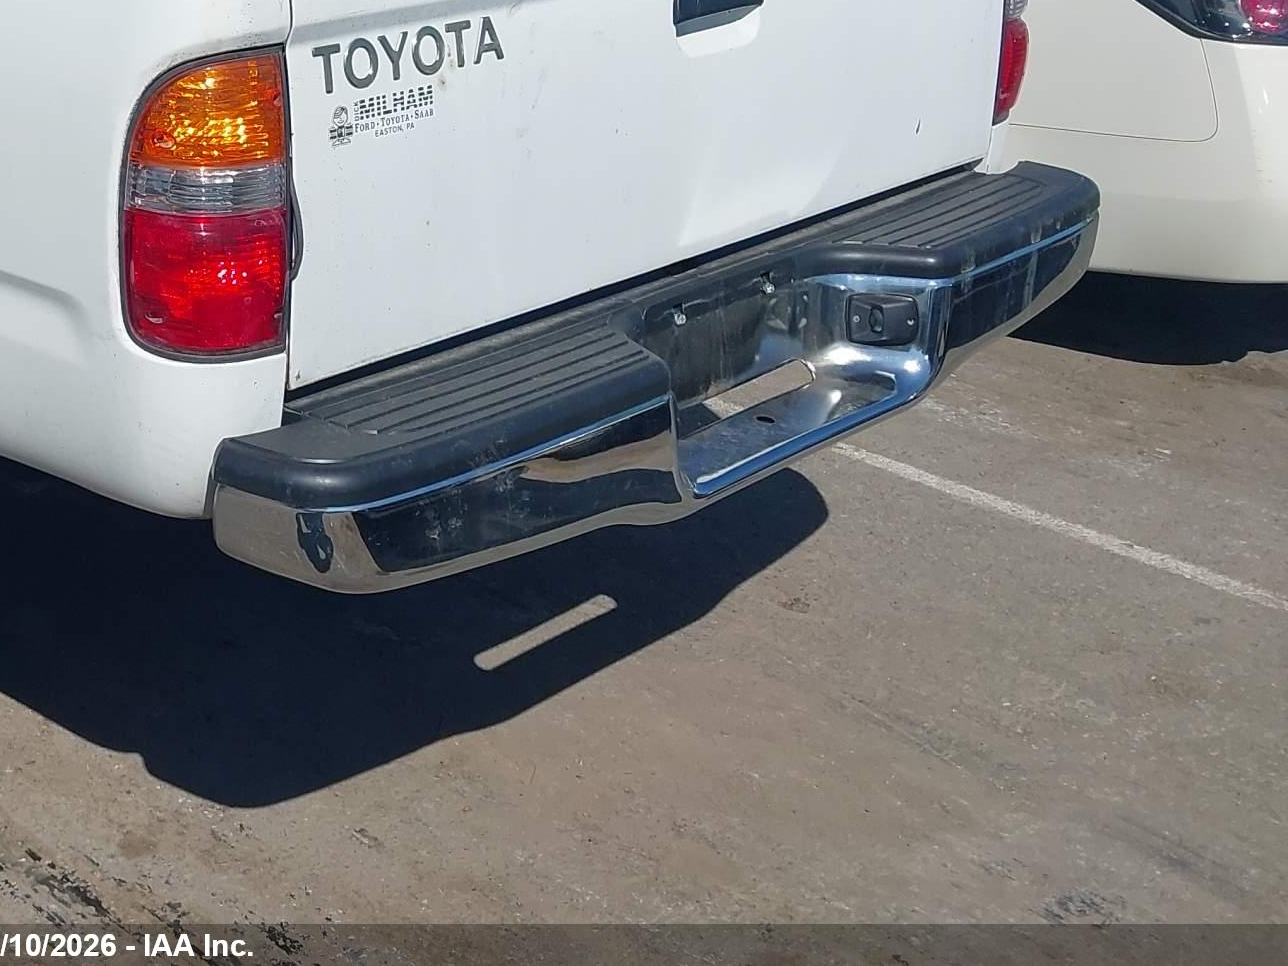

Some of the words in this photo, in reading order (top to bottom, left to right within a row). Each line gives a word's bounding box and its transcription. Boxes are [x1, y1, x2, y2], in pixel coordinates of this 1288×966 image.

[312, 16, 505, 94] TOYOTA
[359, 85, 433, 120] MILHAM
[406, 122, 415, 130] PA
